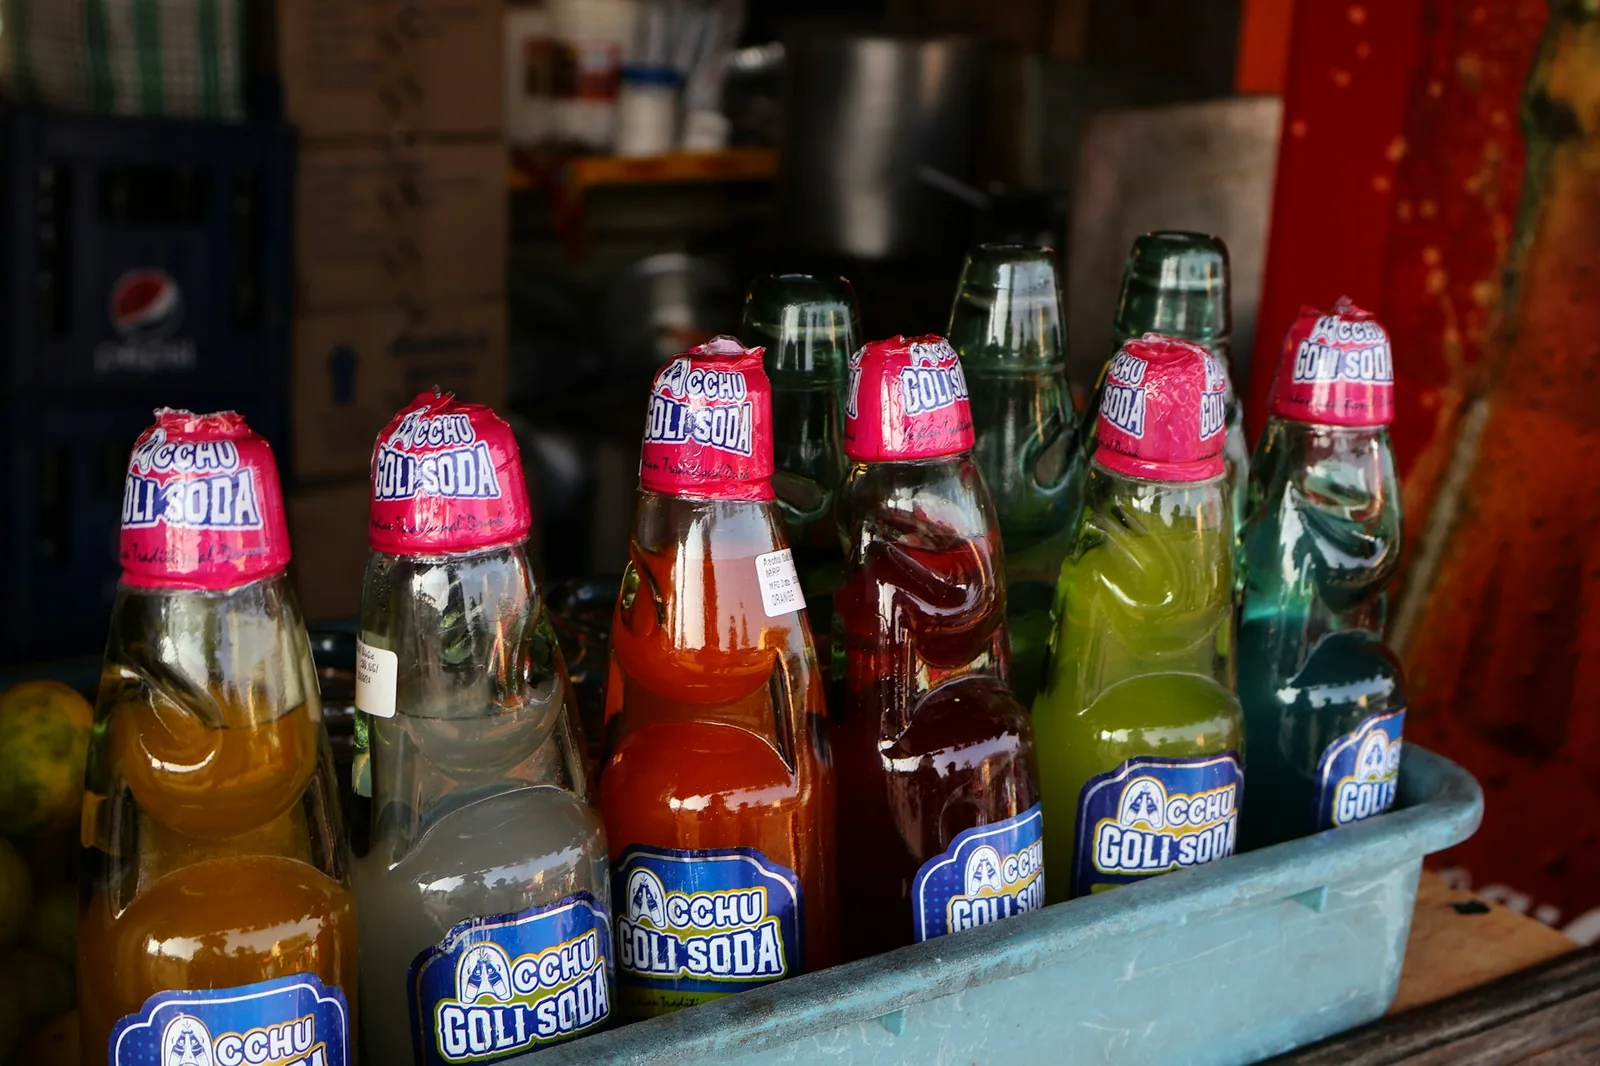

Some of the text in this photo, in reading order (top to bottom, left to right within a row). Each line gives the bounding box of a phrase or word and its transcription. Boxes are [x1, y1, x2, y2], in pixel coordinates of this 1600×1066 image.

[654, 358, 746, 399] ACCHU
[1294, 340, 1393, 382] GOLI SOD
[902, 368, 952, 415] GOLI
[1102, 384, 1146, 437] SODA
[130, 429, 238, 472] ACCHU
[388, 407, 473, 448] ACCHU
[692, 402, 751, 454] SODA
[375, 442, 500, 499] GOLI SODA
[122, 468, 261, 526] OLI SODA
[1120, 778, 1235, 829] ACCHU
[1099, 812, 1238, 870] GOLI SODA
[628, 869, 764, 928] ACCHU
[460, 934, 597, 1005] ACCHU
[618, 917, 783, 976] GOLI SODA
[441, 961, 609, 1057] GOLI SODA
[163, 1016, 312, 1066] ACCHU
